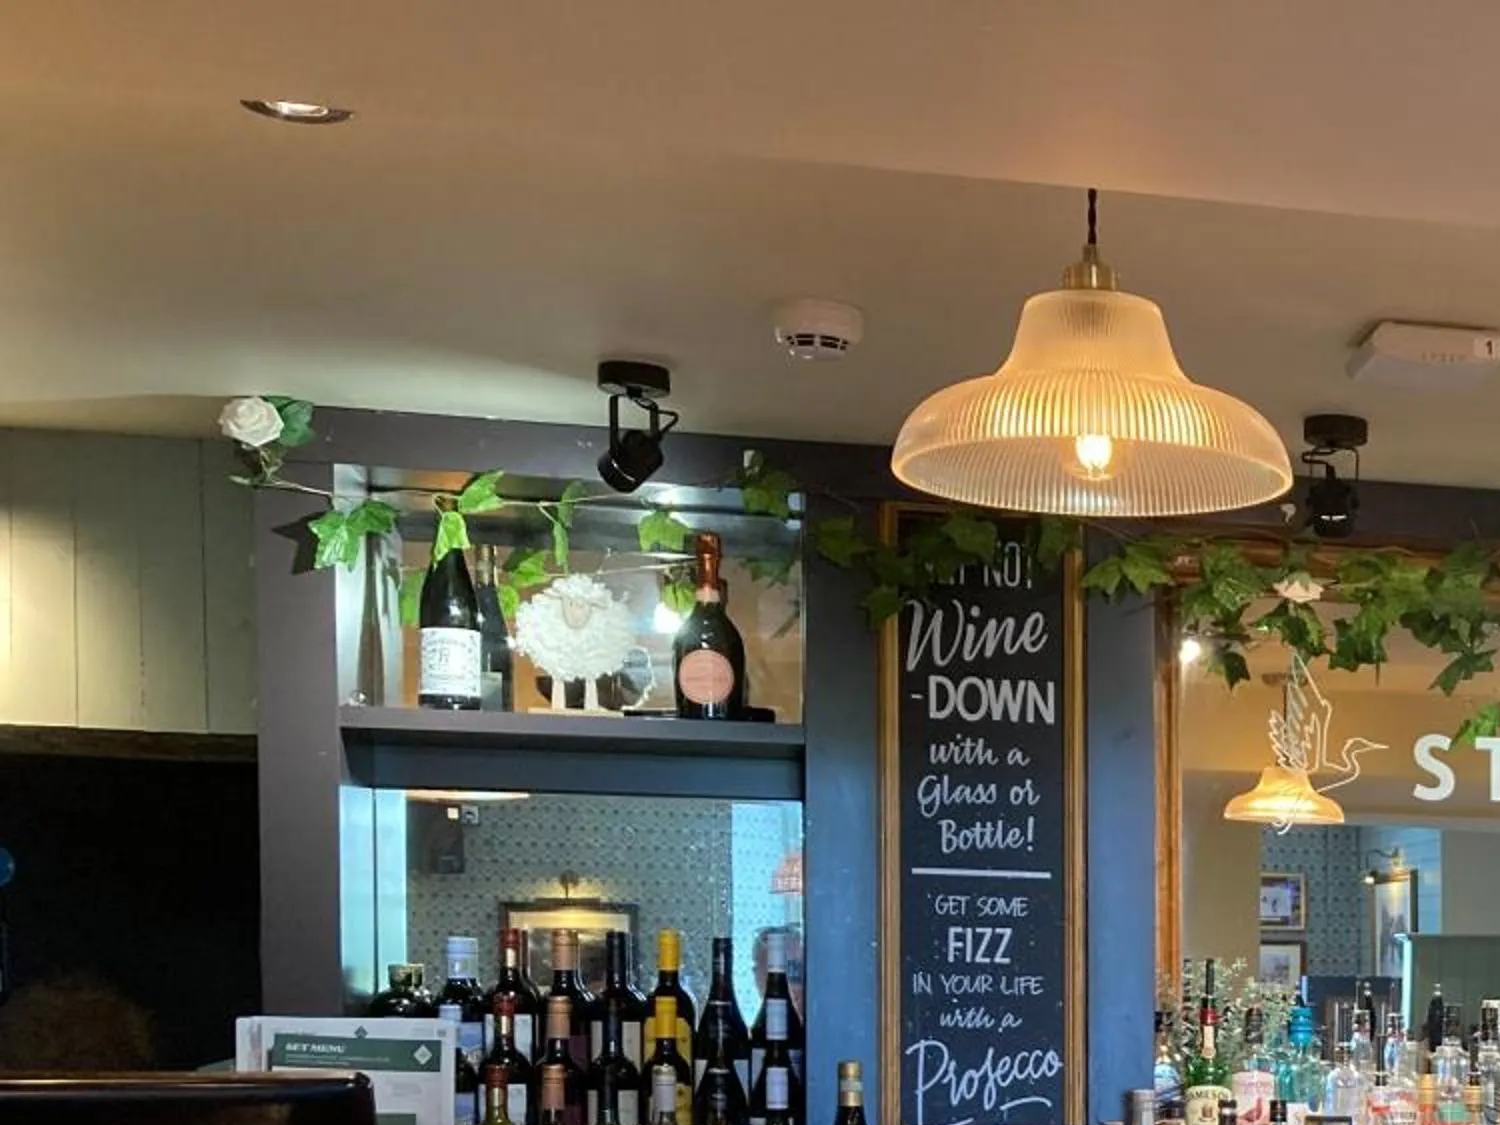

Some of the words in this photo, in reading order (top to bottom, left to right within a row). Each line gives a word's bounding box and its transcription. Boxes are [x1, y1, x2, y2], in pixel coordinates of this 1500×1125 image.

[1485, 340, 1494, 356] 1
[904, 598, 1049, 672] Wine
[929, 732, 999, 766] with
[1007, 747, 1030, 766] a
[916, 775, 998, 818] Glass
[1009, 778, 1041, 806] or
[937, 815, 1036, 854] Bottle!
[934, 894, 970, 915] GET
[976, 896, 1029, 917] SOME
[946, 926, 1013, 964] FIZZ
[912, 971, 932, 994] IN
[939, 973, 993, 995] YOUR
[1000, 976, 1045, 996] LIFE
[939, 998, 995, 1028] with
[1001, 1010, 1022, 1028] a
